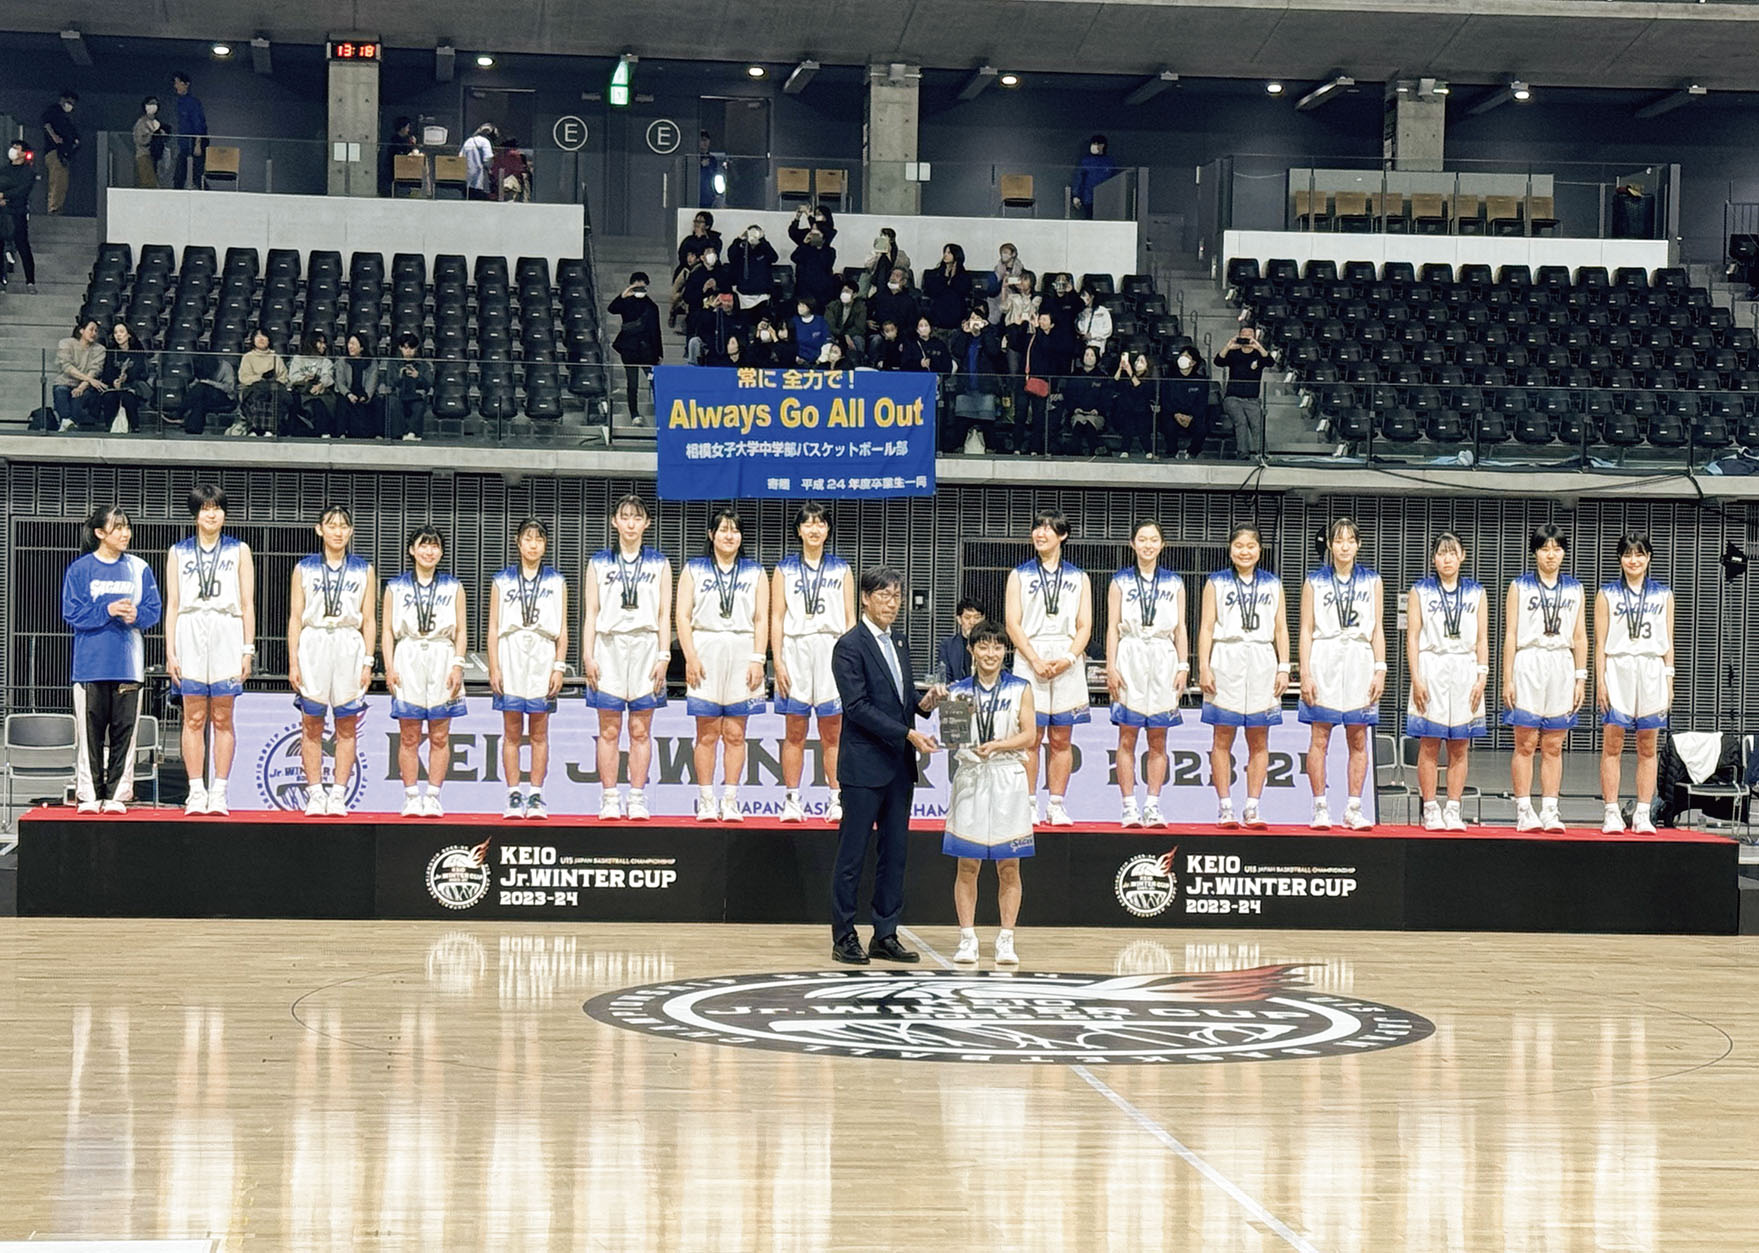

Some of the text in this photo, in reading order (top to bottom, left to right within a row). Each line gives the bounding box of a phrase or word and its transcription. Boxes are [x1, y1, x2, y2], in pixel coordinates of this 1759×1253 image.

[337, 43, 376, 57] 13:18
[737, 368, 777, 389] 常に
[668, 396, 924, 435] Always Go All Out
[686, 441, 908, 459] 相模女子大学中学部バスケットボール部
[500, 846, 557, 866] KEIO
[1186, 855, 1241, 874] KEIO
[628, 871, 678, 889] CUP
[1310, 879, 1358, 897] CUP
[500, 891, 579, 907] 2023-24
[1185, 900, 1262, 915] 2023-24
